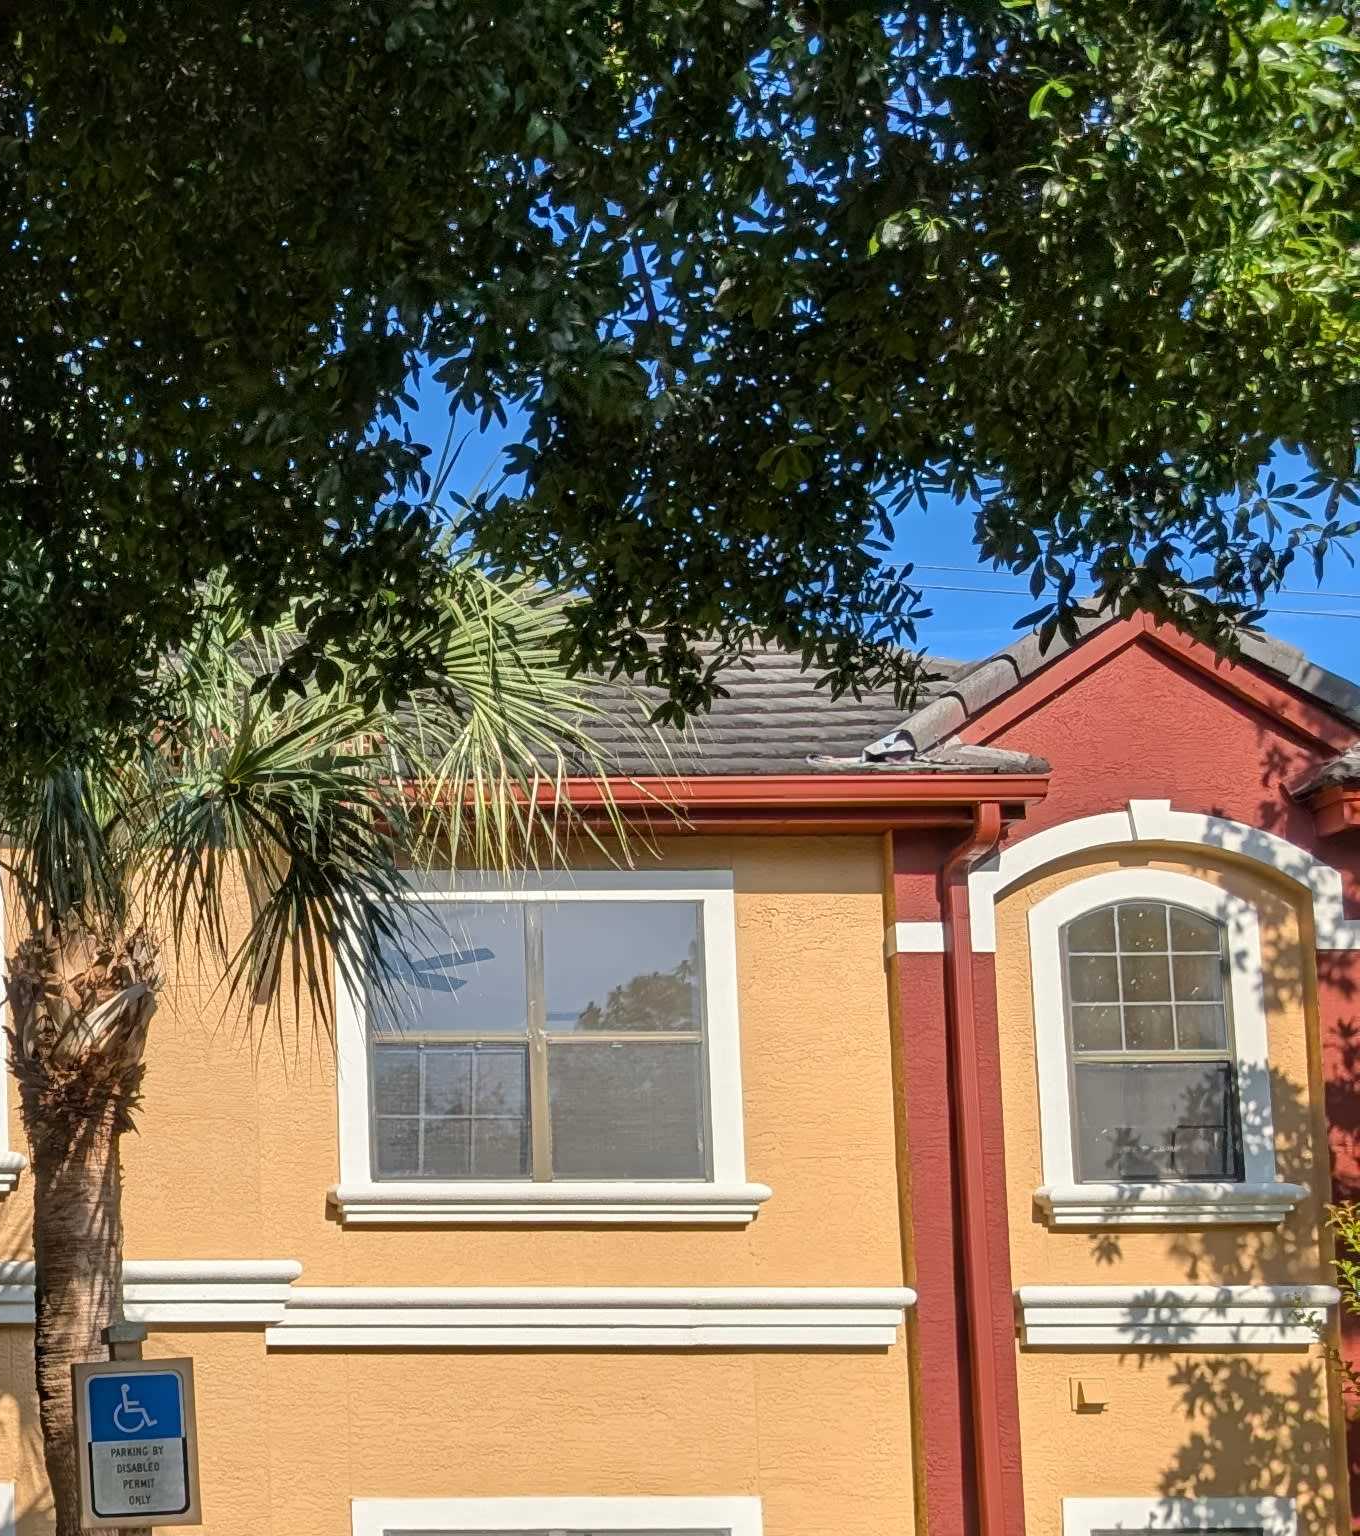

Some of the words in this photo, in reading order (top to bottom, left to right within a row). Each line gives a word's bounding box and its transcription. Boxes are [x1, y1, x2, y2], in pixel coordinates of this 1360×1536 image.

[110, 1446, 149, 1457] PARKING
[152, 1445, 164, 1456] BY
[116, 1462, 160, 1473] DISABLED
[122, 1478, 155, 1489] PERMIT
[128, 1495, 151, 1505] ONLY
